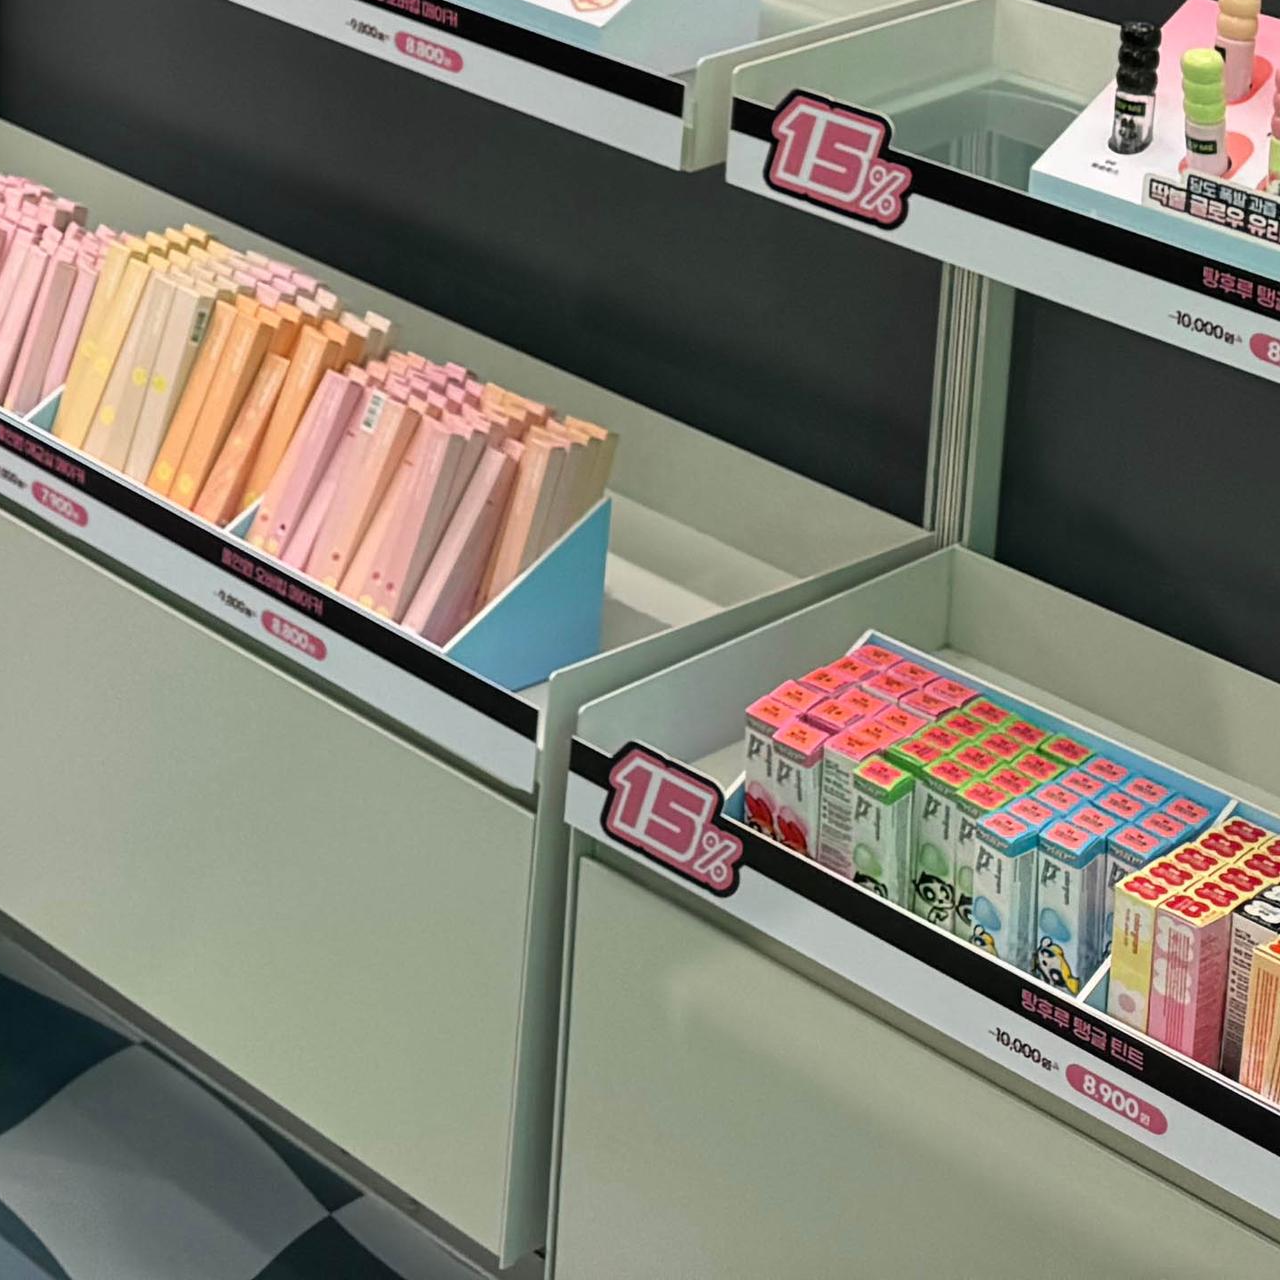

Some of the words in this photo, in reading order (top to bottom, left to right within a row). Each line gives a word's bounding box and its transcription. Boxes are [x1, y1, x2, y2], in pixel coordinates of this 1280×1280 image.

[775, 98, 910, 223] 15%
[609, 752, 741, 890] 15%
[1021, 988, 1070, 1029] 탕후루
[1073, 1016, 1107, 1052] 탱글
[1111, 1036, 1144, 1071] 틴트
[1082, 1074, 1151, 1127] 8,900원
